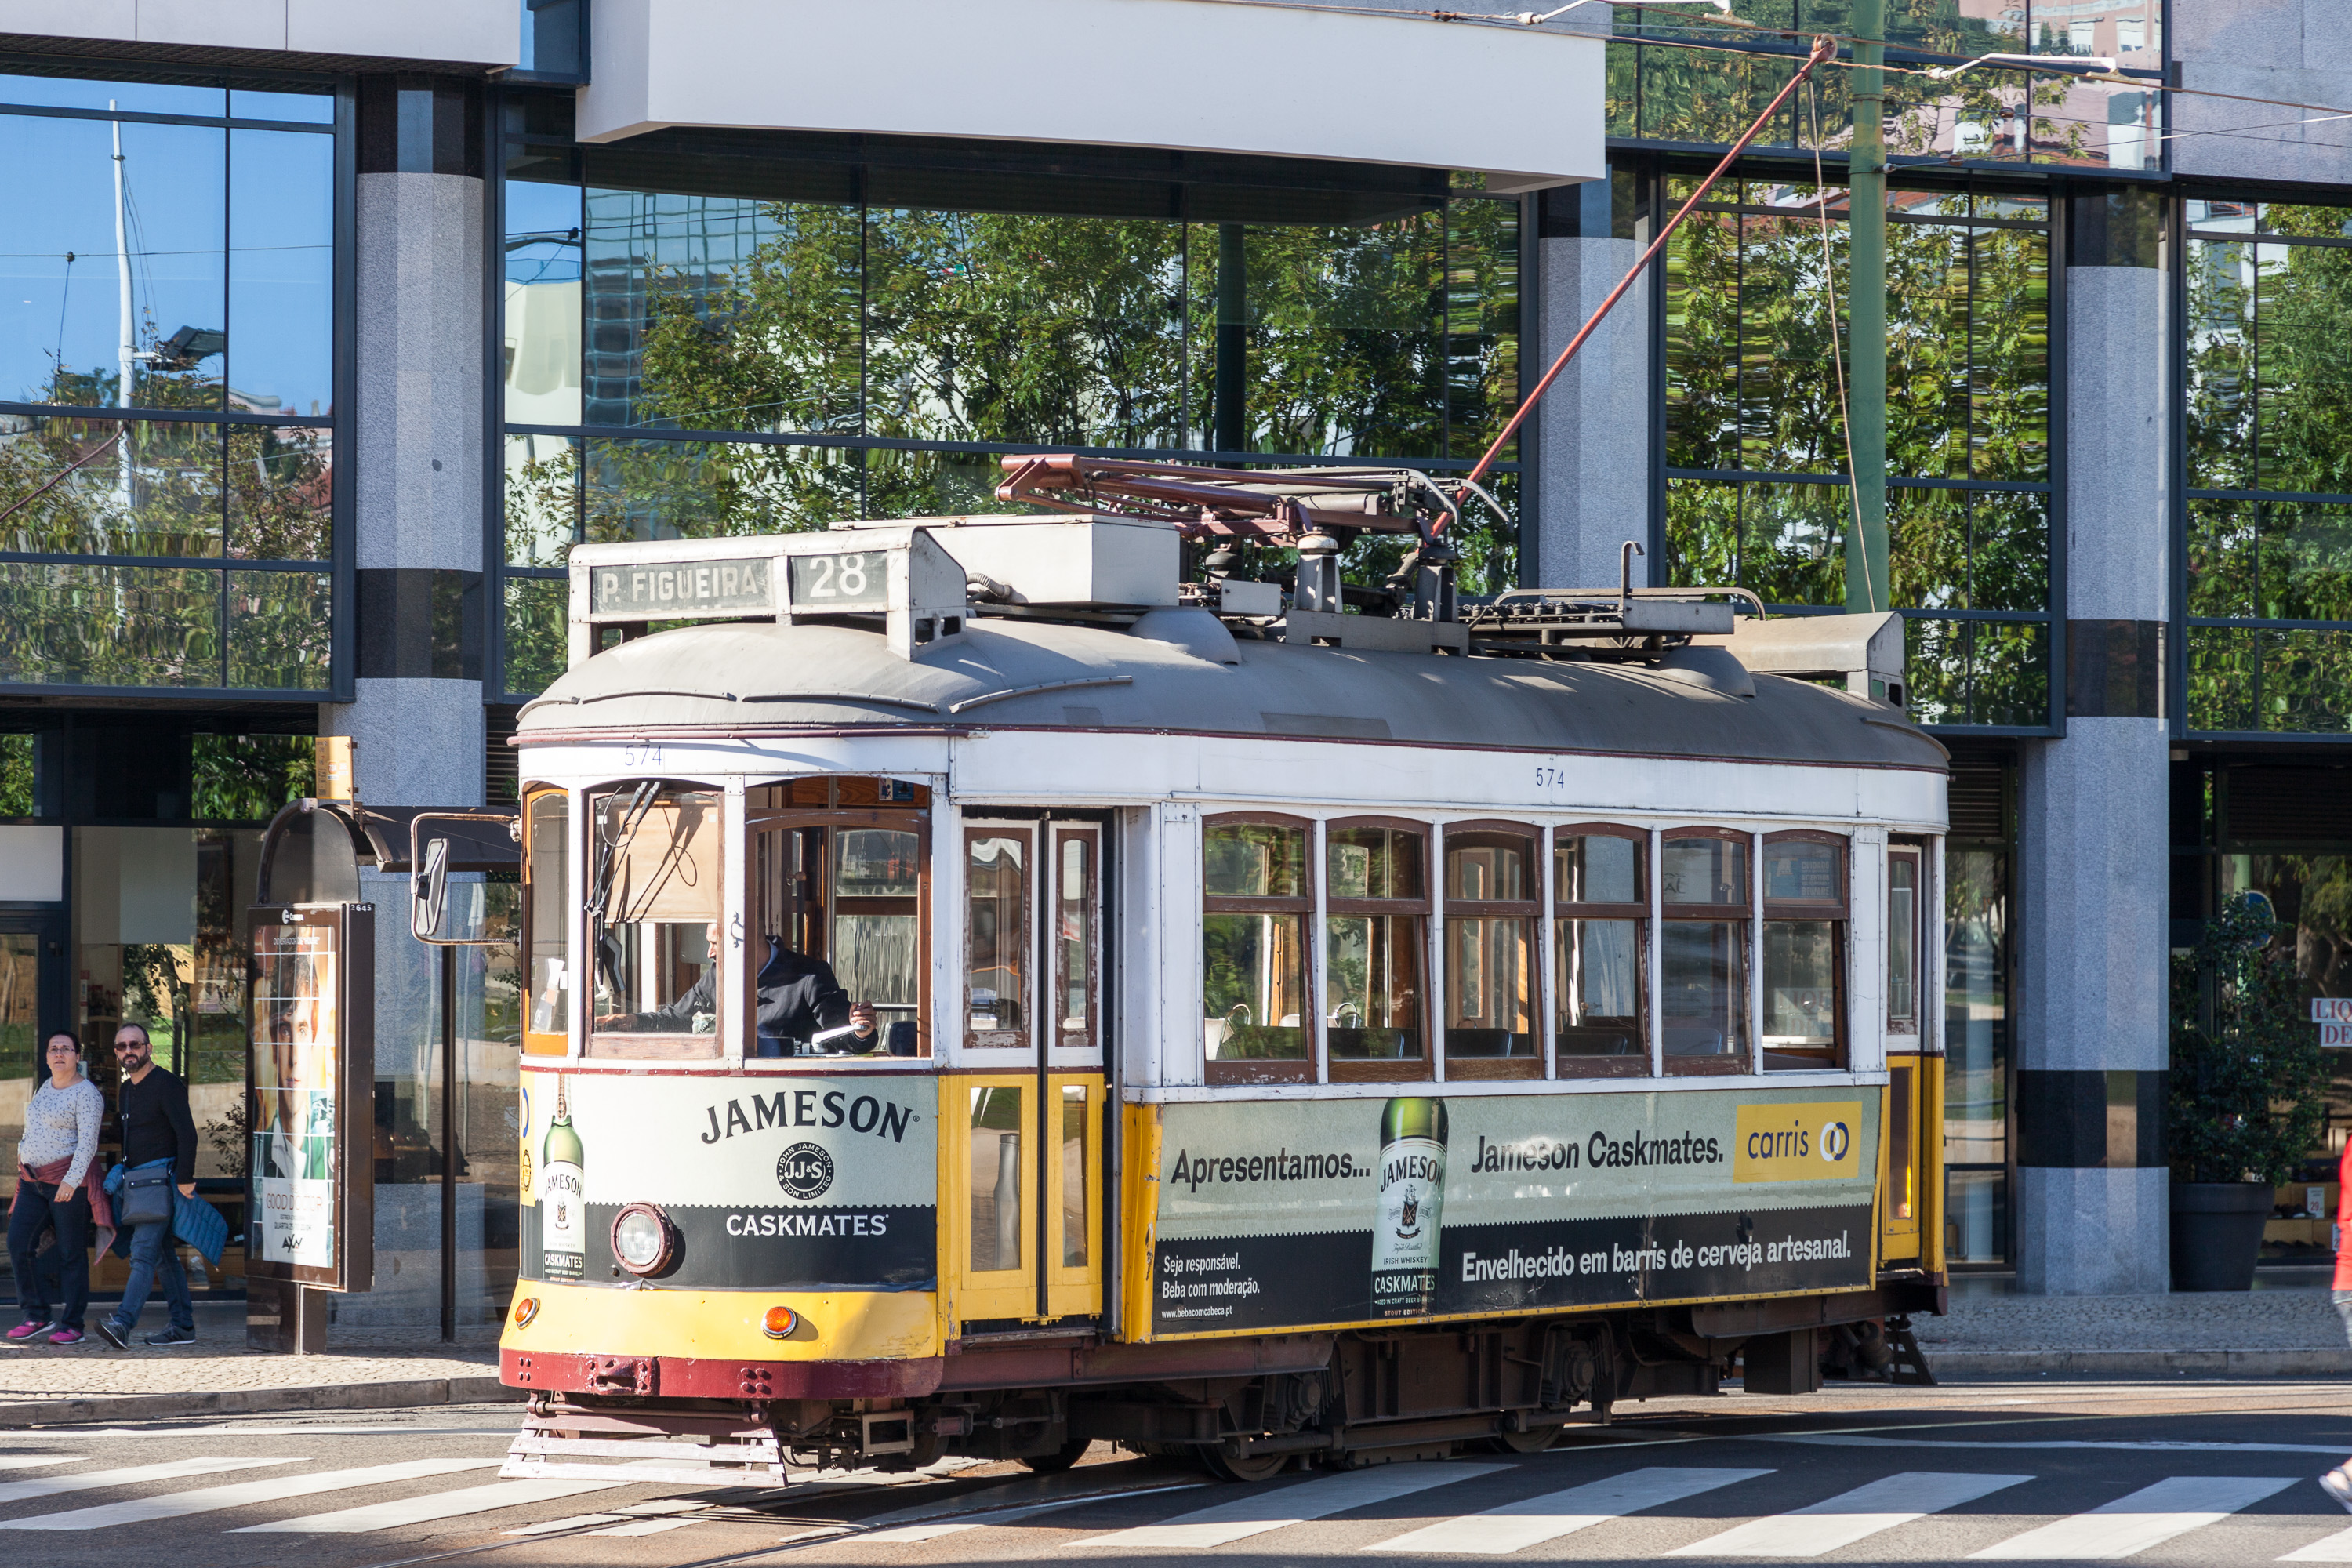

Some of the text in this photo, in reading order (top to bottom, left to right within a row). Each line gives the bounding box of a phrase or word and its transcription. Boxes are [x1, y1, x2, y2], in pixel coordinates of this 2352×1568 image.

[601, 564, 758, 604] P. FIGUEIRA
[809, 554, 867, 598] 28
[625, 745, 662, 766] 574
[1537, 768, 1565, 789] 574
[1471, 1129, 1724, 1174] Jameson Caskmates.
[1748, 1120, 1809, 1160] carris
[779, 1143, 832, 1169] JOHN JAMESON
[1171, 1147, 1371, 1193] Apresentamos...
[1381, 1156, 1443, 1192] JAMESON
[545, 1174, 583, 1199] JAMESON
[783, 1183, 800, 1198] SON
[803, 1175, 832, 1199] LIMITED
[267, 1192, 289, 1210] GOOD
[726, 1214, 887, 1236] CASKMATES
[544, 1253, 583, 1269] CASKMATES
[1163, 1252, 1241, 1277] Seja responsável.
[1461, 1229, 1852, 1283] Envelhecido em barris de cerveja artesanal.
[1163, 1277, 1260, 1298] Beba com moderação.
[1374, 1275, 1436, 1294] CASKMATES
[1161, 1305, 1232, 1319] www.bebacomcabeca.pt
